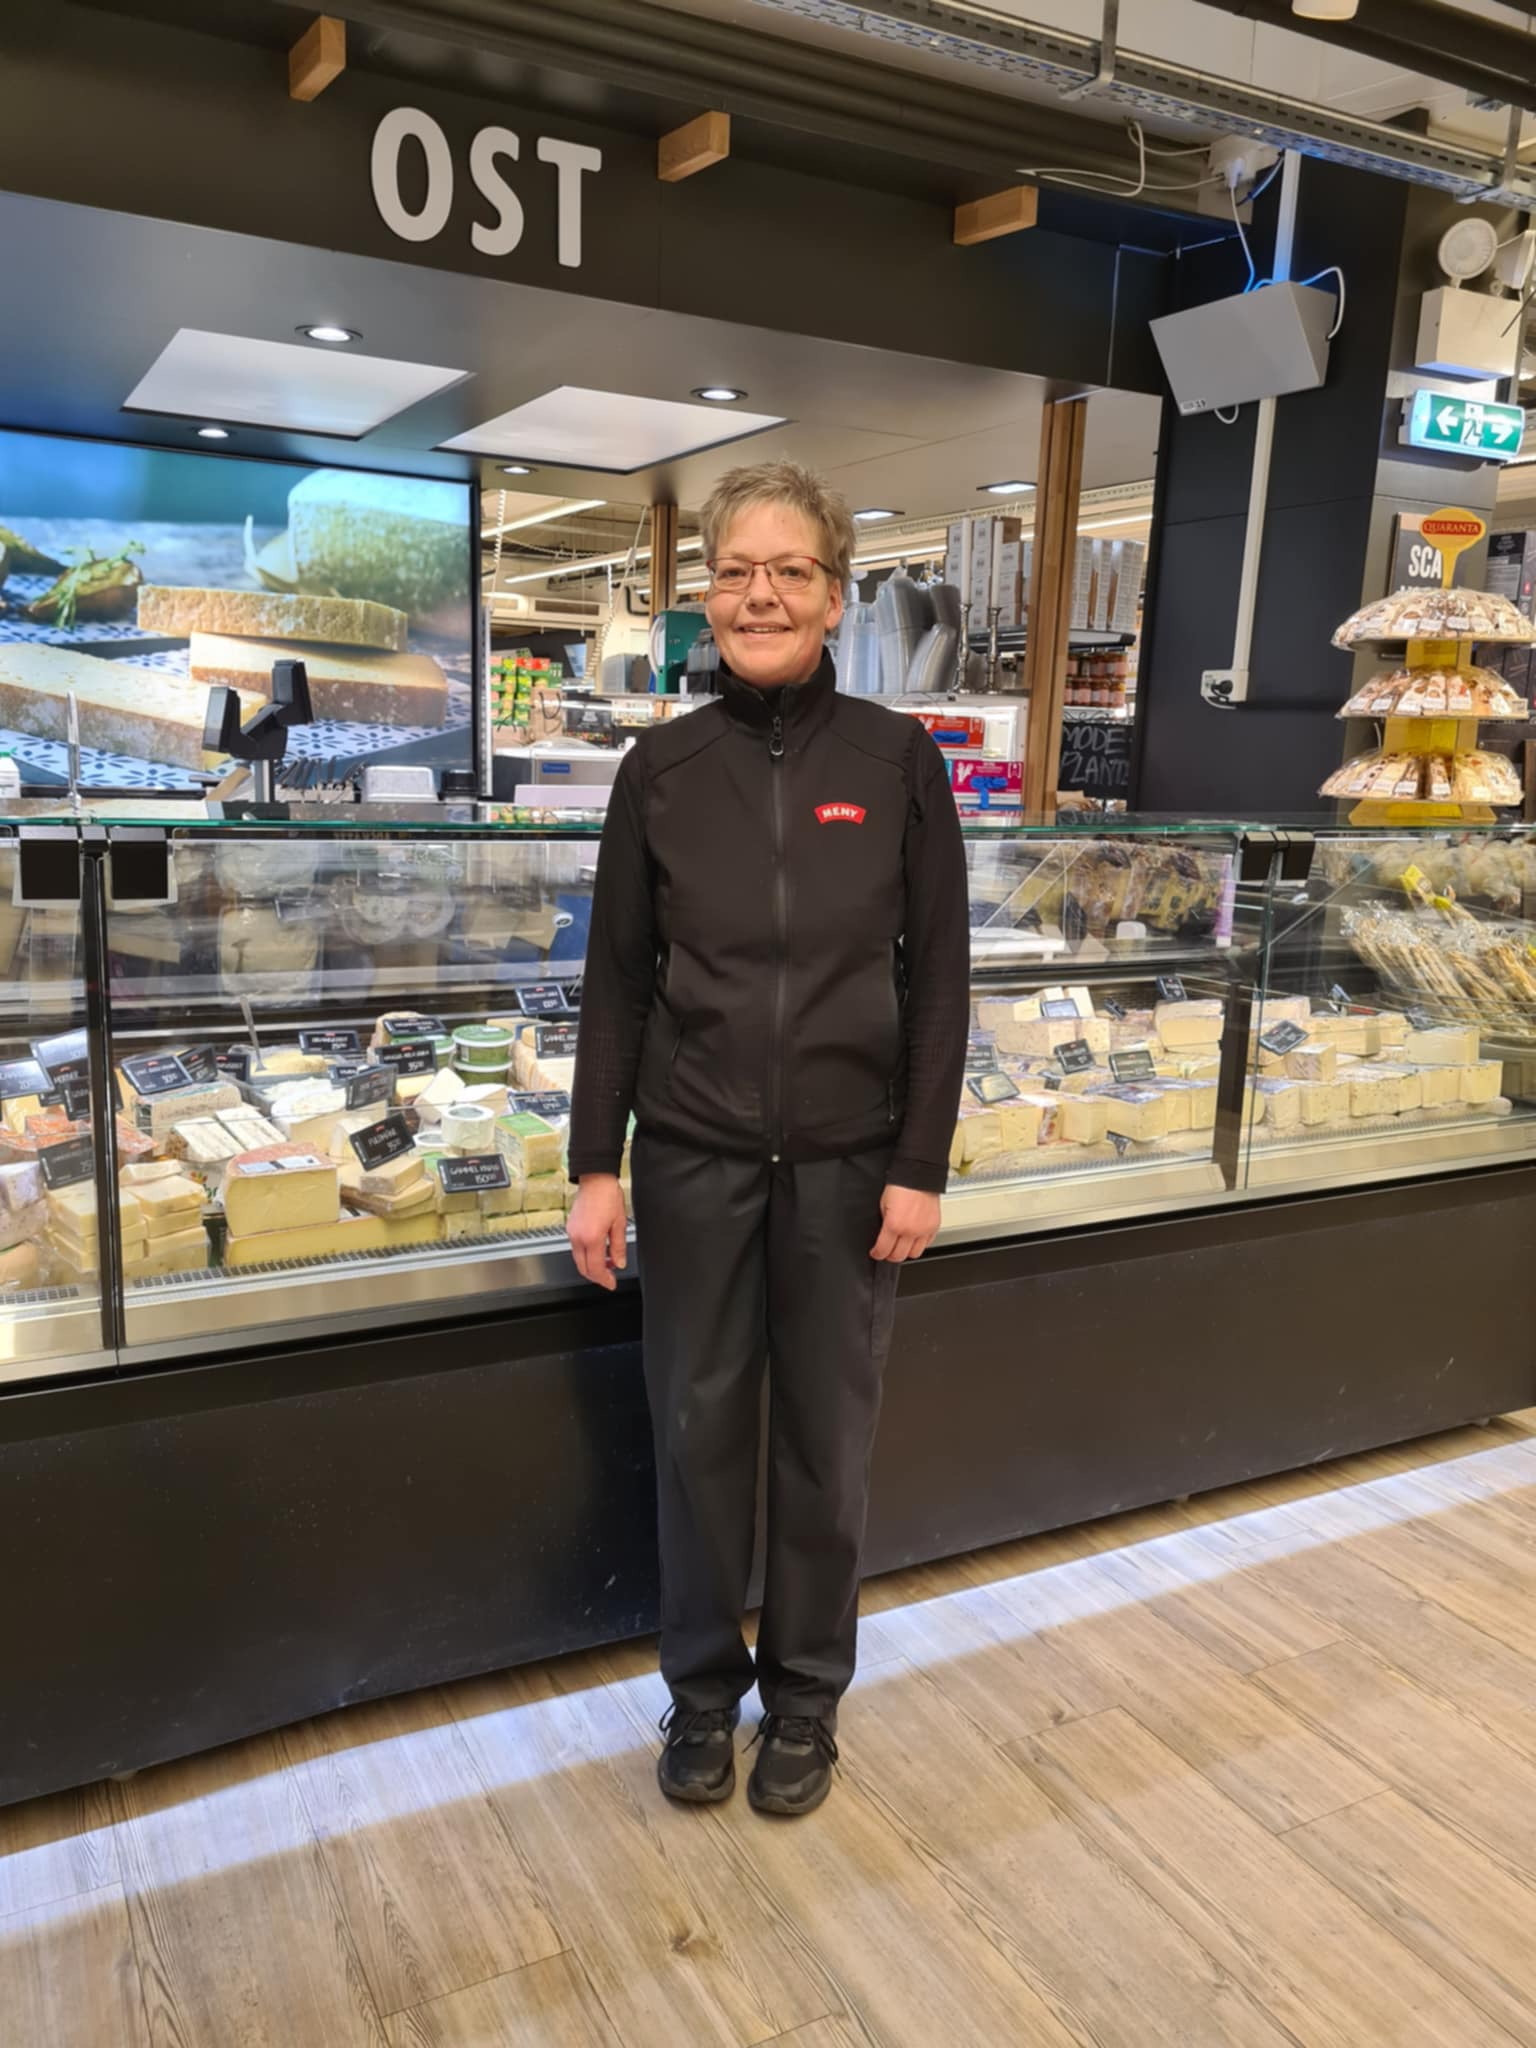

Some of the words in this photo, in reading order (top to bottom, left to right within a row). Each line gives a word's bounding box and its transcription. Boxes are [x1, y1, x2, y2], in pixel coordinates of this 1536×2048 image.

[371, 107, 602, 268] OST
[1423, 521, 1480, 534] QUARANTA
[822, 806, 858, 818] MENY
